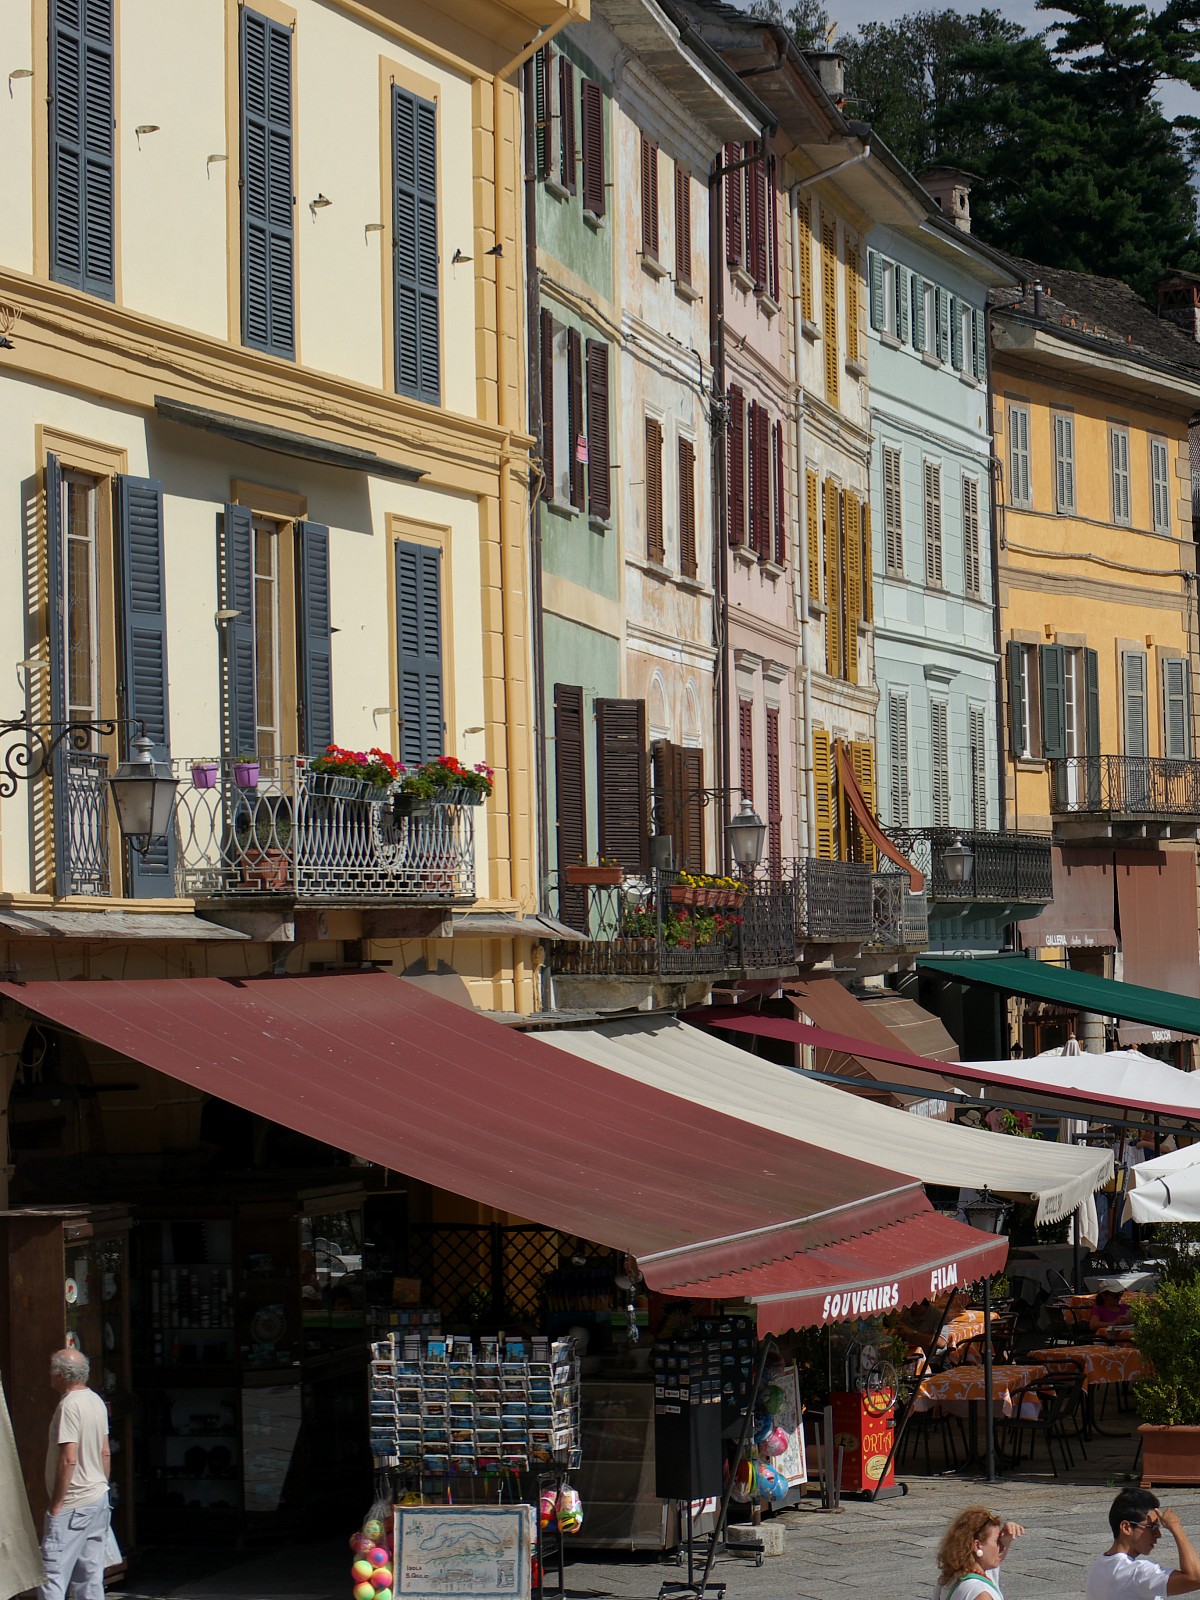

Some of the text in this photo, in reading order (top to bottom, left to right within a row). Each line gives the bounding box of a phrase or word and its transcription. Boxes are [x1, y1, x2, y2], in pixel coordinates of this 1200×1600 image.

[822, 1263, 958, 1320] SOUVENIRS FILM
[863, 1431, 892, 1453] ORTA
